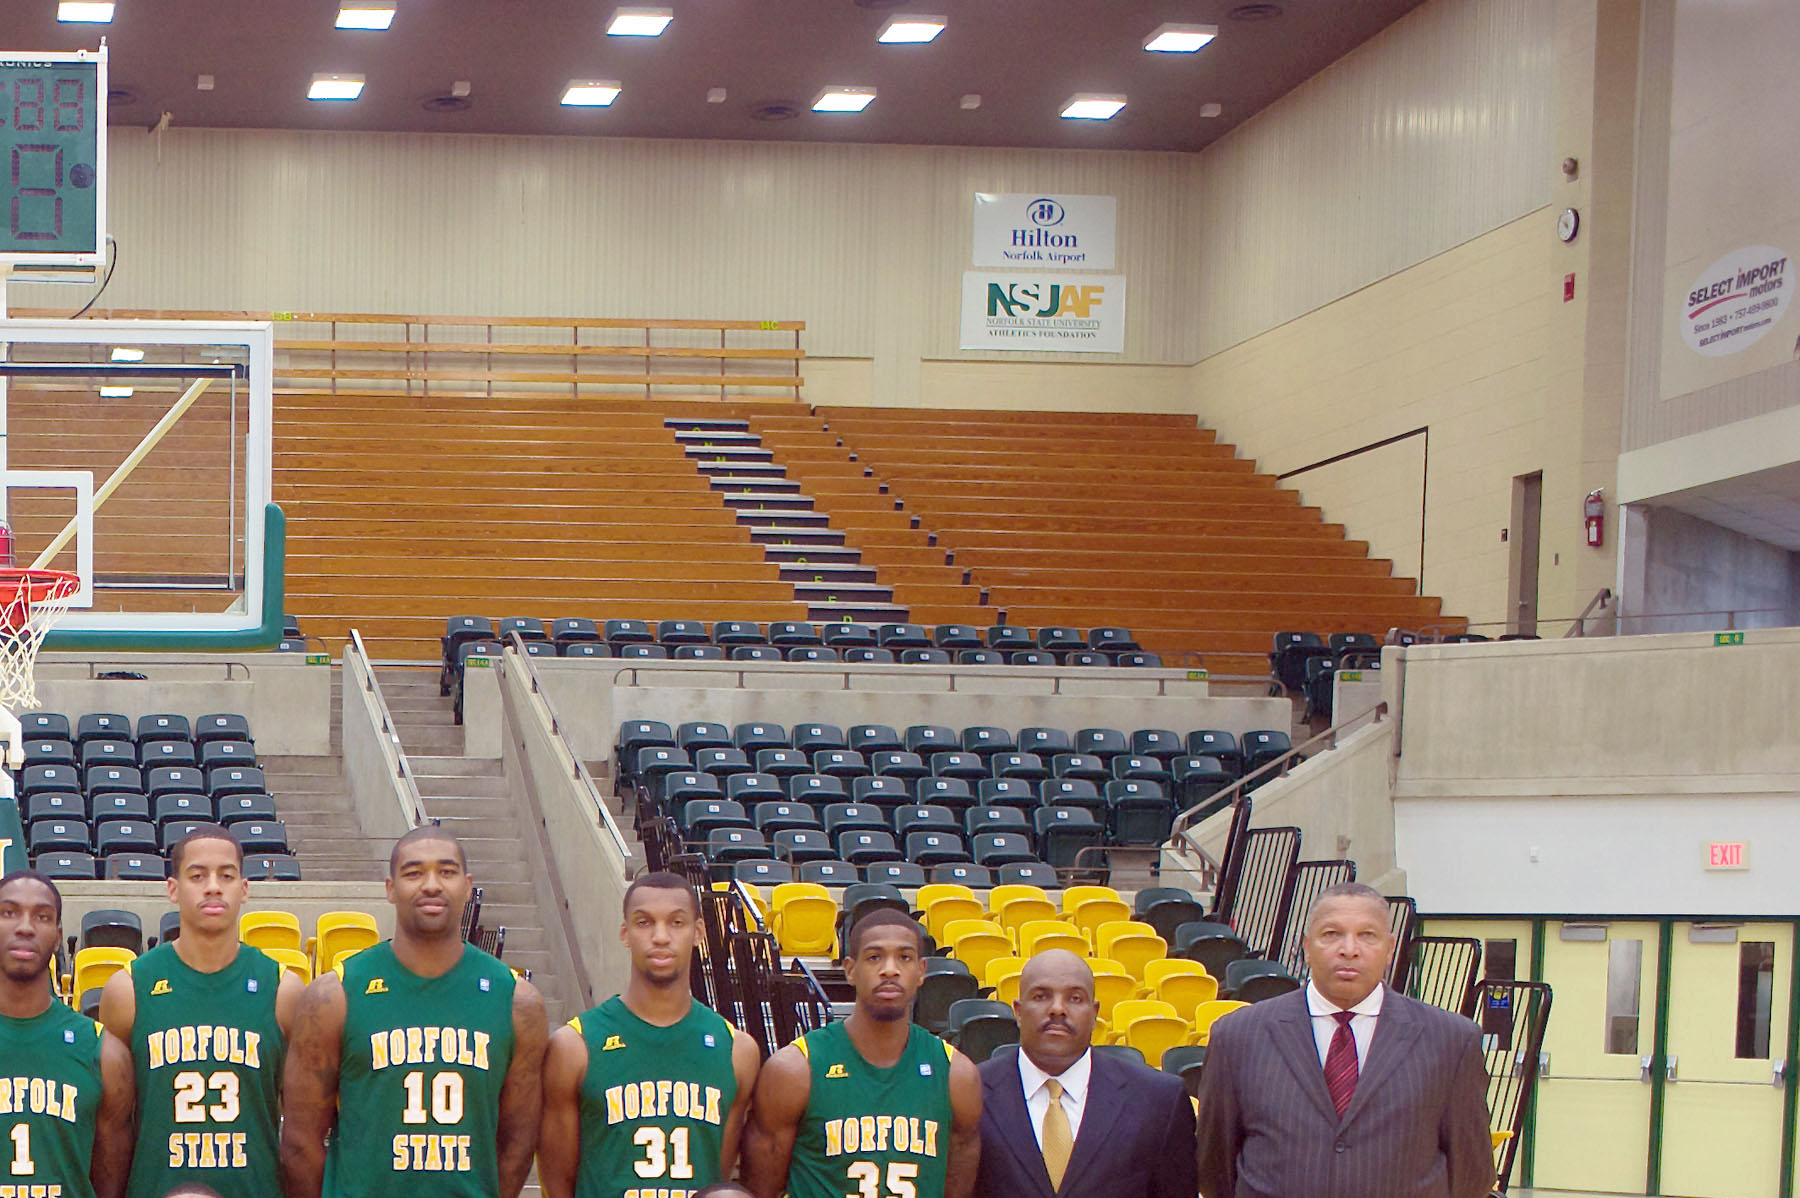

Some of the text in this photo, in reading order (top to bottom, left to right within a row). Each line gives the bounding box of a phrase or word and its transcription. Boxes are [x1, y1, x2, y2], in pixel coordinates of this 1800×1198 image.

[1011, 228, 1078, 248] Hilton
[1003, 251, 1086, 264] Norfolk Airport
[1688, 277, 1734, 307] SELECT
[1749, 277, 1783, 298] motors
[986, 317, 1101, 328] NORFOLK STATE UNIVERSITY
[988, 329, 1097, 339] ATHLETICS FOUNDATION
[1710, 843, 1744, 866] EXIT
[148, 1025, 261, 1070] NORFOLK
[370, 1026, 490, 1071] NORFOLK
[173, 1070, 241, 1123] 23
[402, 1071, 464, 1124] 10
[605, 1080, 721, 1125] NORFOLK
[9, 1123, 34, 1176] 1
[168, 1132, 247, 1168] STATE
[392, 1134, 471, 1171] STATE
[633, 1126, 694, 1179] 31
[825, 1115, 938, 1158] NORFOLK
